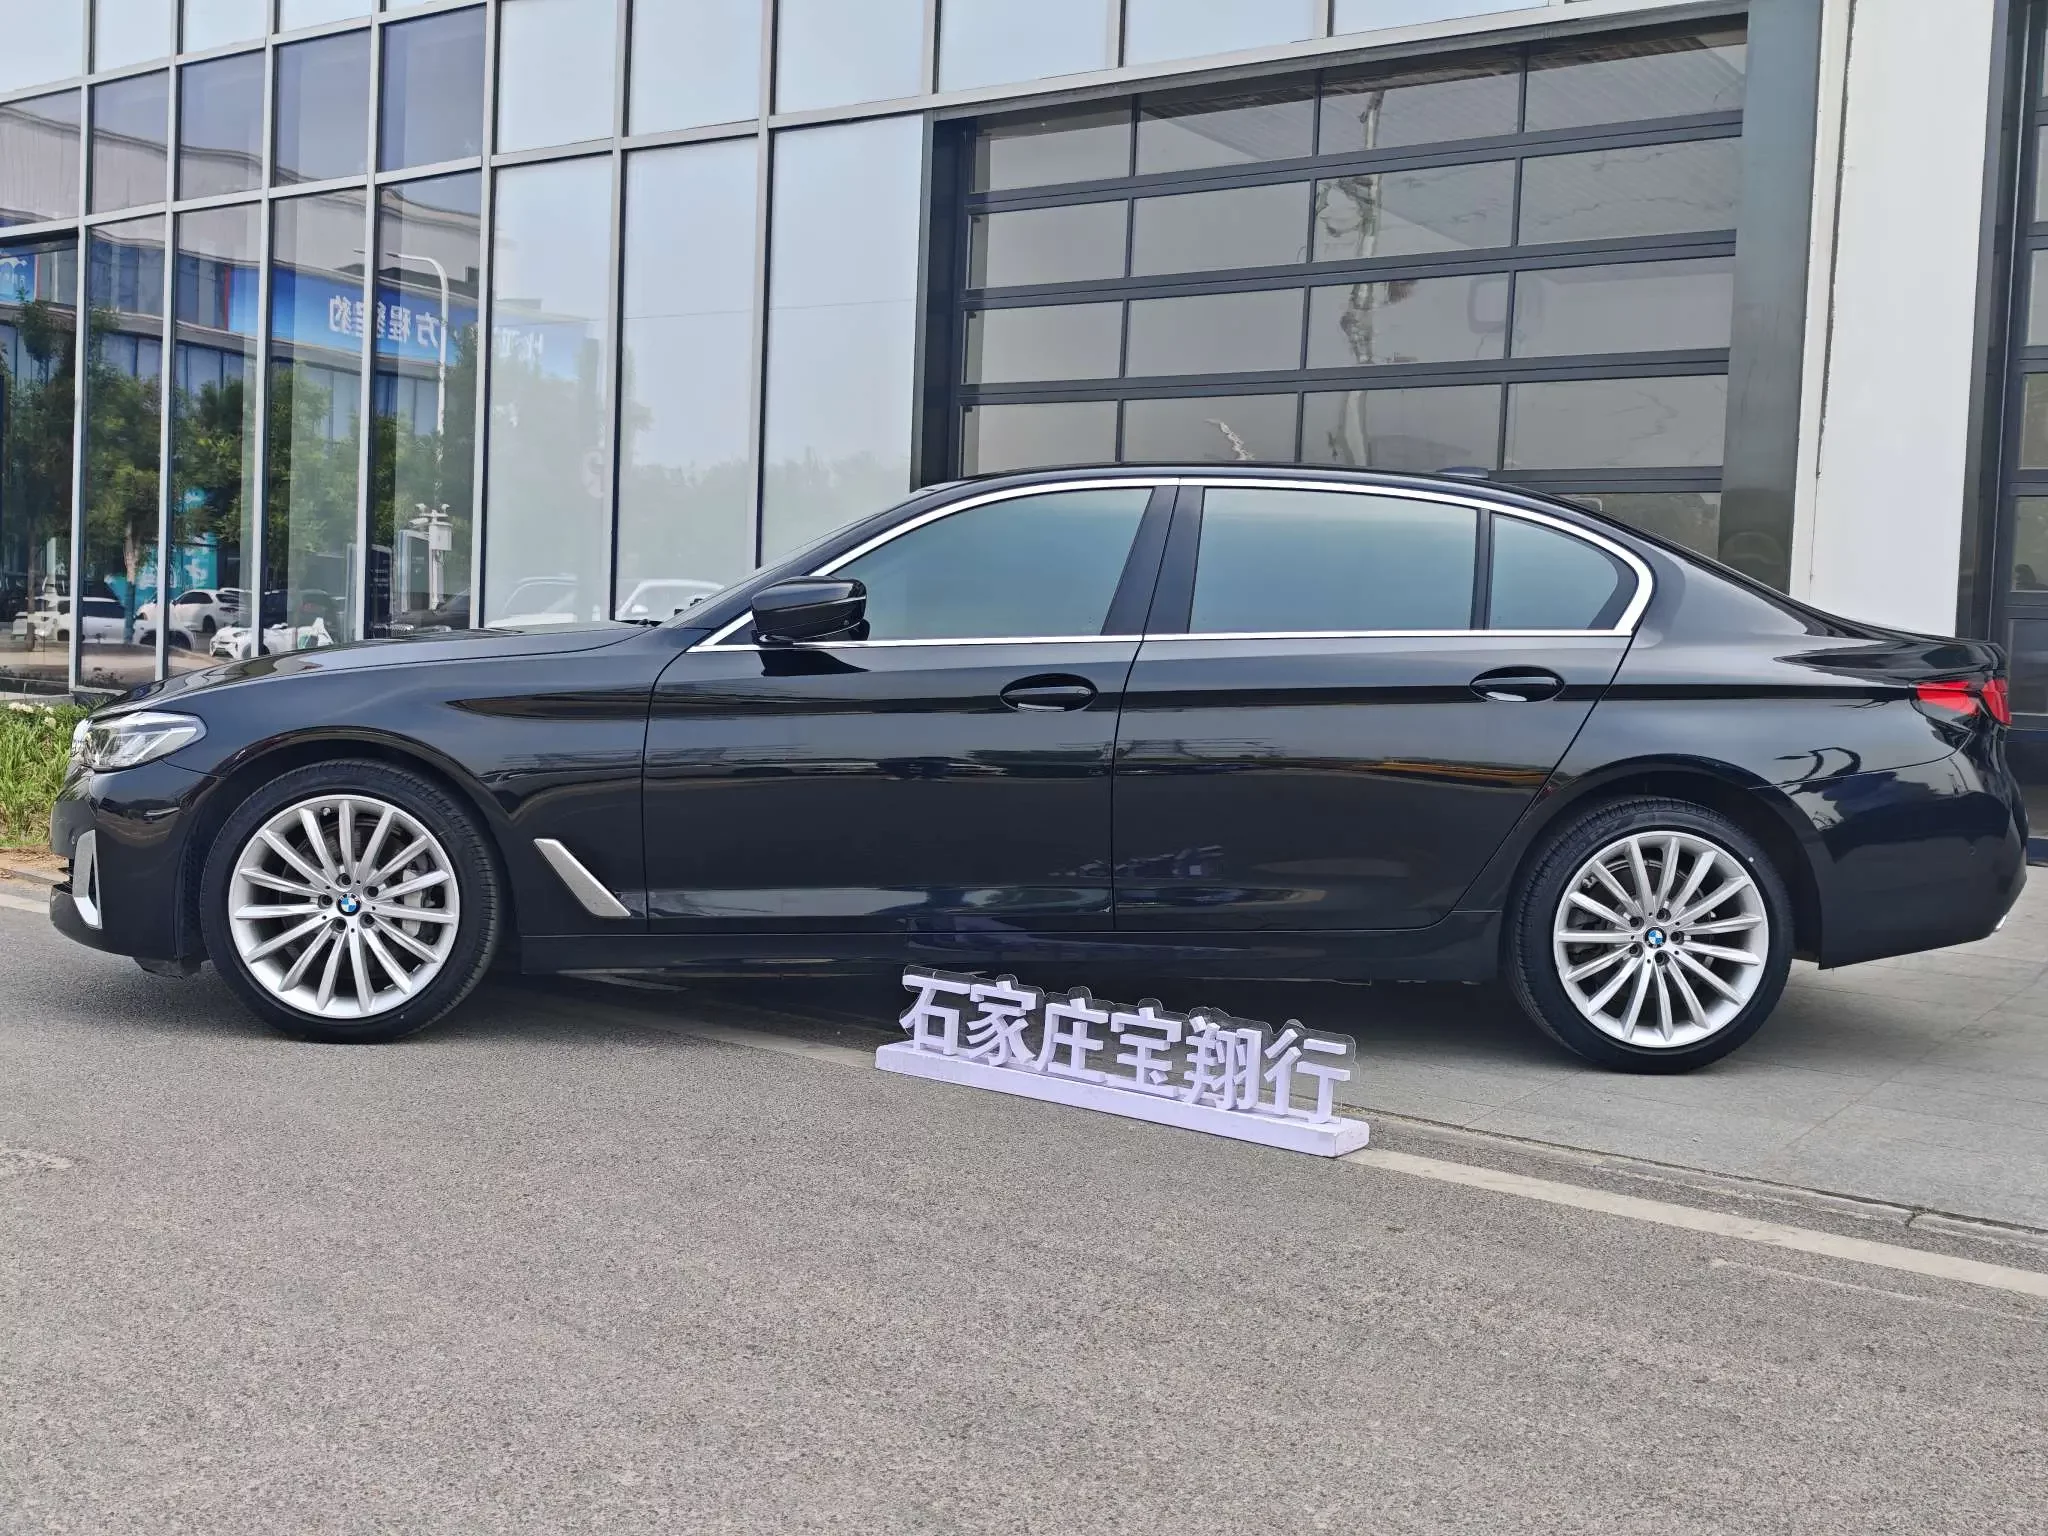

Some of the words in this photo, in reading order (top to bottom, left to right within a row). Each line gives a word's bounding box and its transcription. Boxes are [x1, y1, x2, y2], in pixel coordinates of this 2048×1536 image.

[899, 975, 1351, 1124] 石家庄宝翔行
